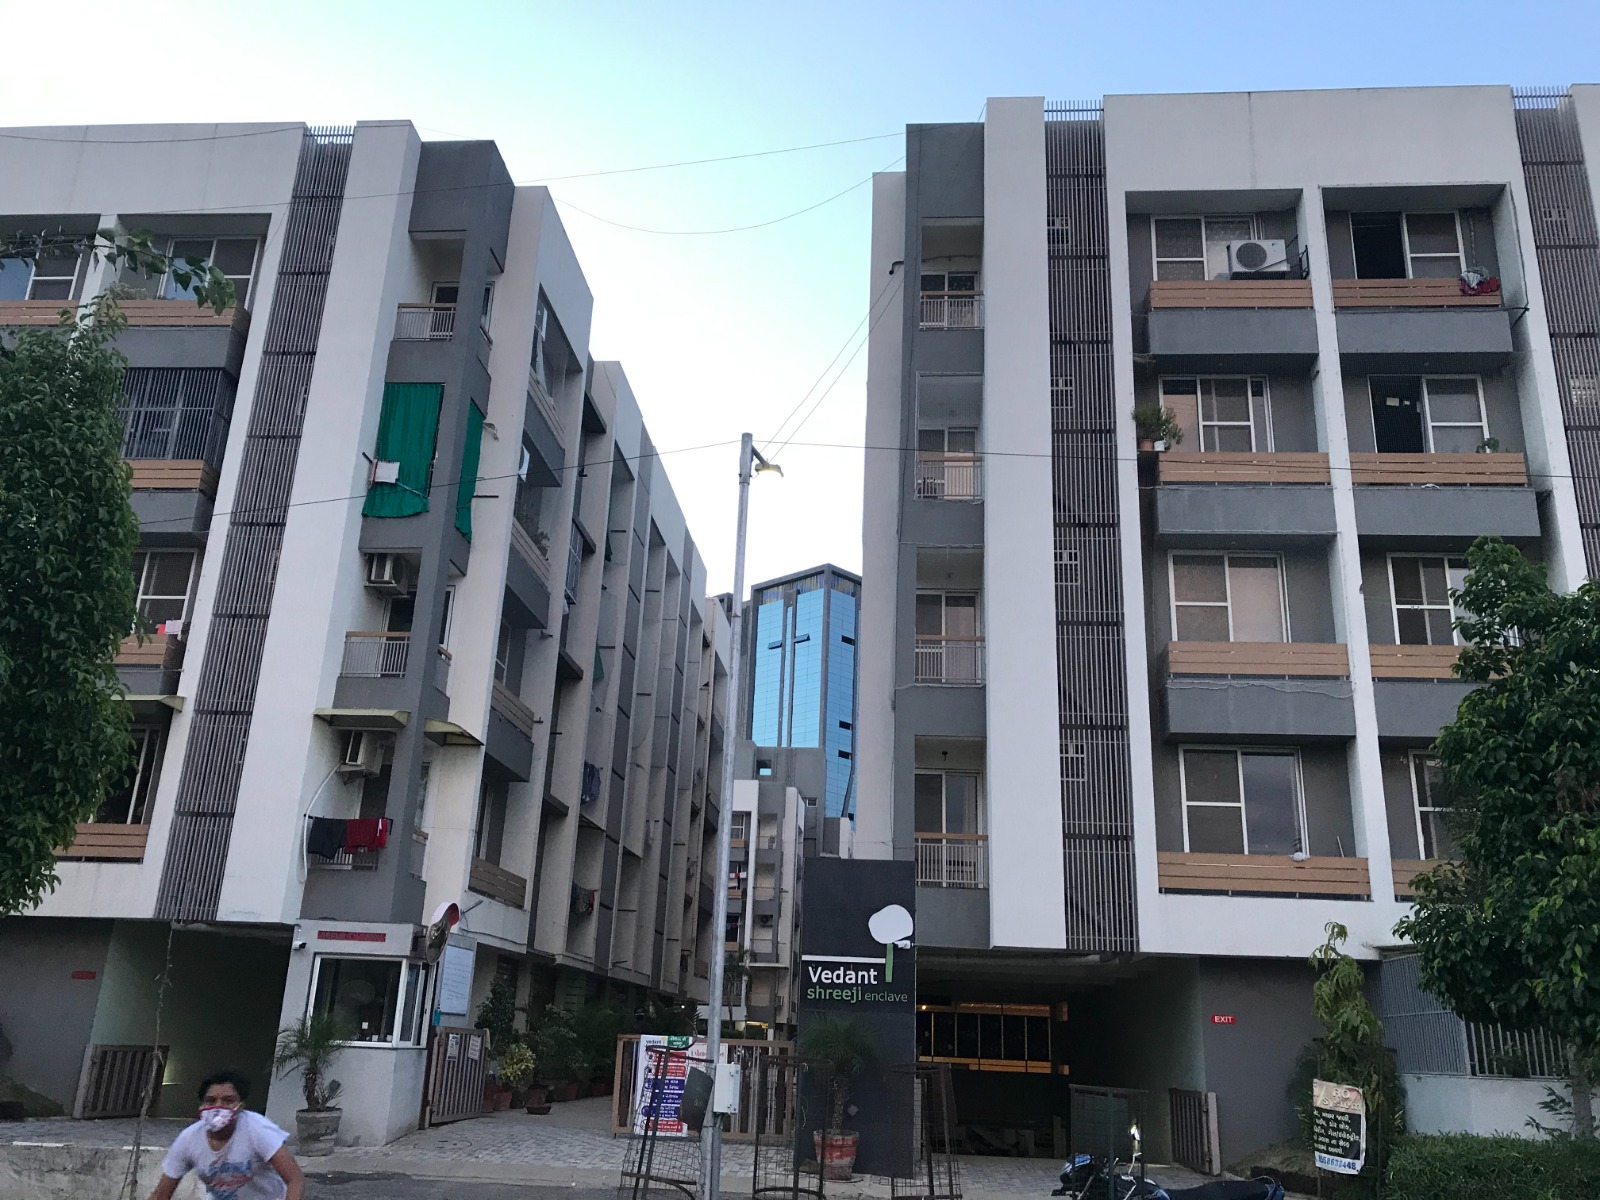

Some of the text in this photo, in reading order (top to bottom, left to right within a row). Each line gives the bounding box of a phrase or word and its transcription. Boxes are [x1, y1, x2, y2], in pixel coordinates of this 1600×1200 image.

[808, 966, 878, 985] Vedant
[807, 985, 908, 1003] shreeji enclave
[1214, 1015, 1233, 1023] EXIT
[1333, 1087, 1350, 1099] RO
